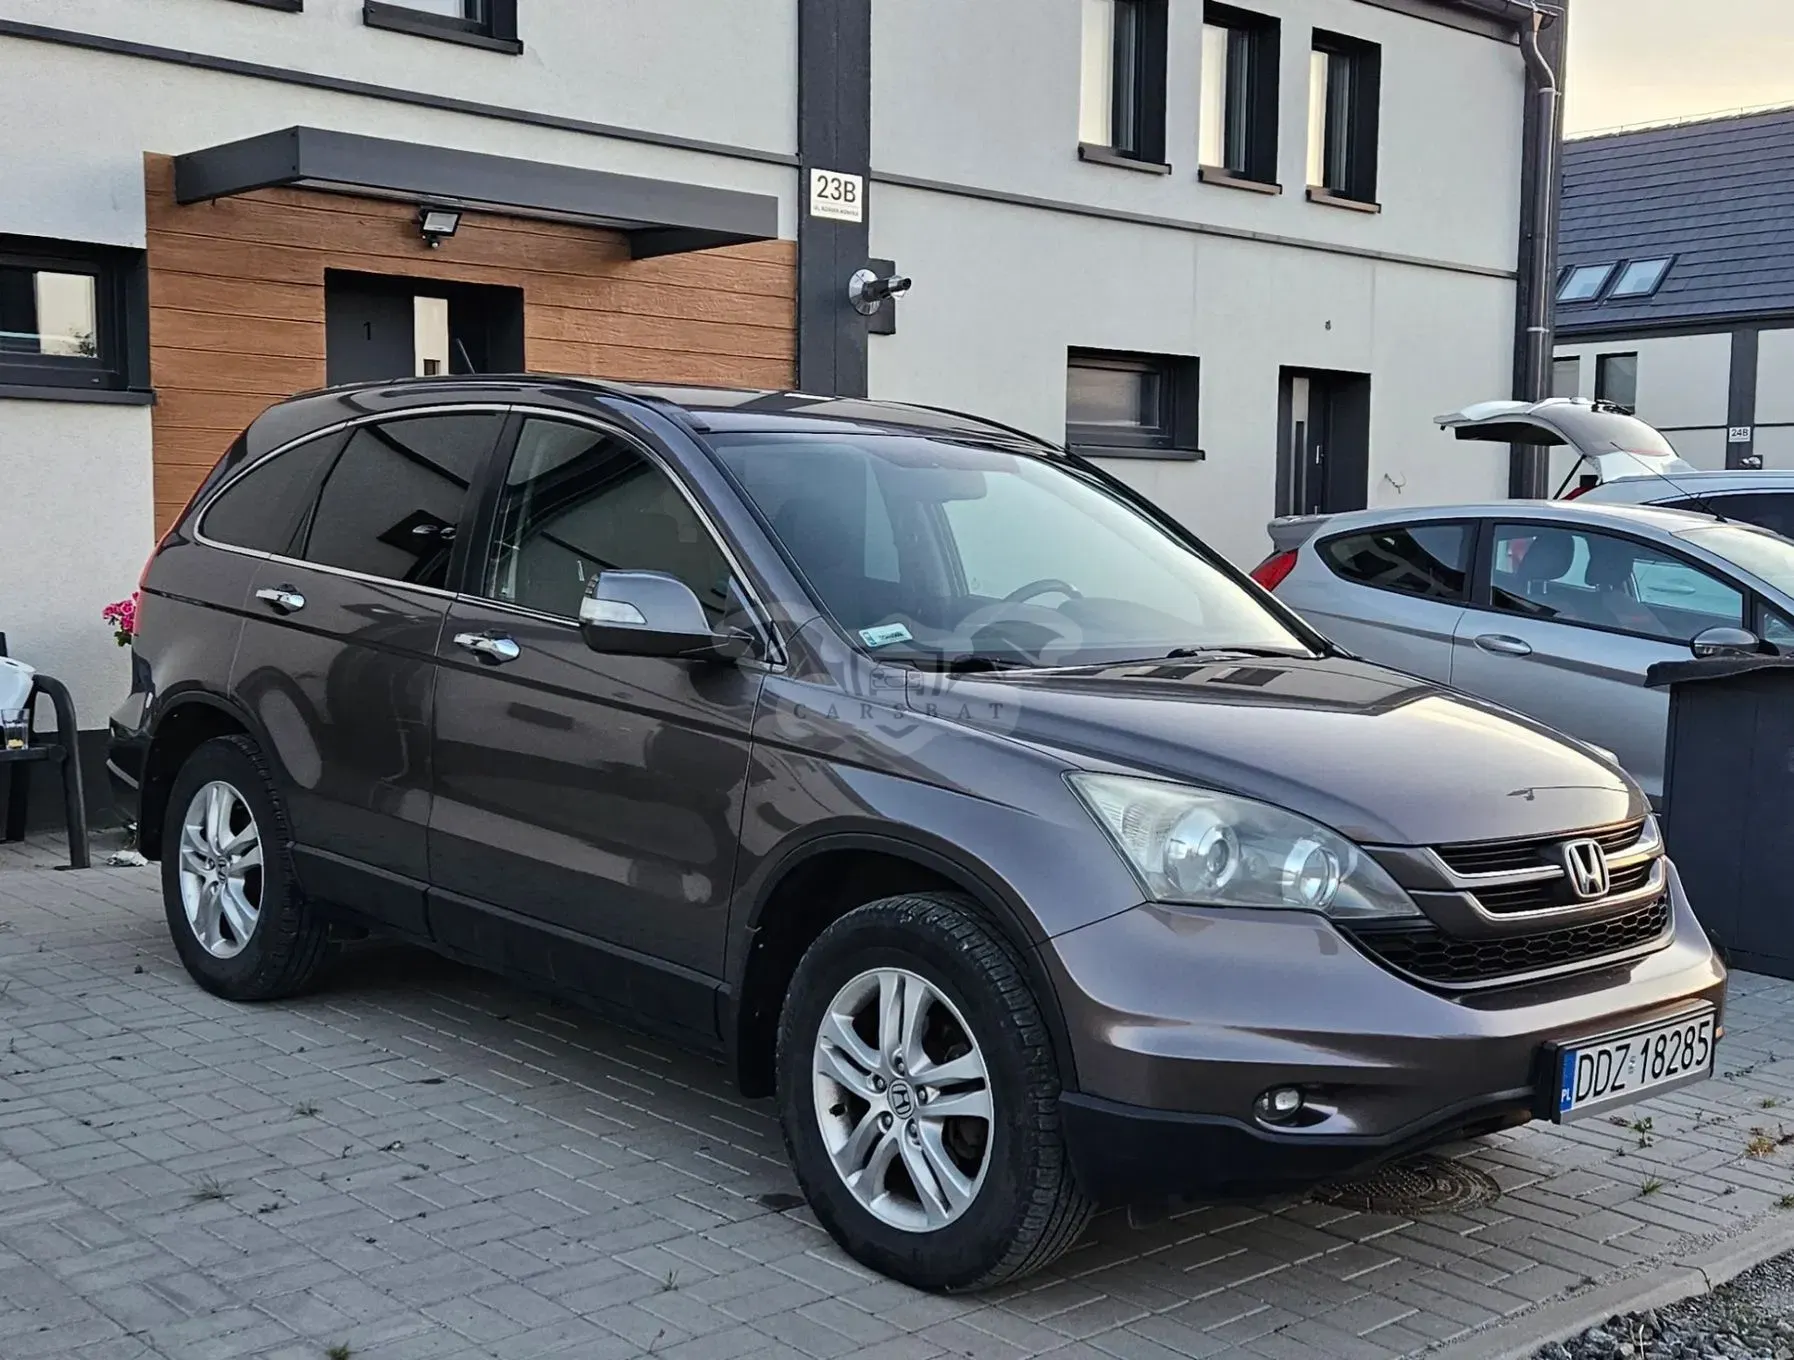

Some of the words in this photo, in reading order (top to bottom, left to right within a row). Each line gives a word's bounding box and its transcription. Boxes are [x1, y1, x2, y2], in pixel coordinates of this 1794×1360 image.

[817, 175, 856, 203] 23B
[363, 321, 372, 341] 1
[1731, 428, 1749, 437] 24B
[1575, 1043, 1631, 1103] DDZ
[1640, 1020, 1711, 1084] 18285
[1560, 1088, 1572, 1103] PL
